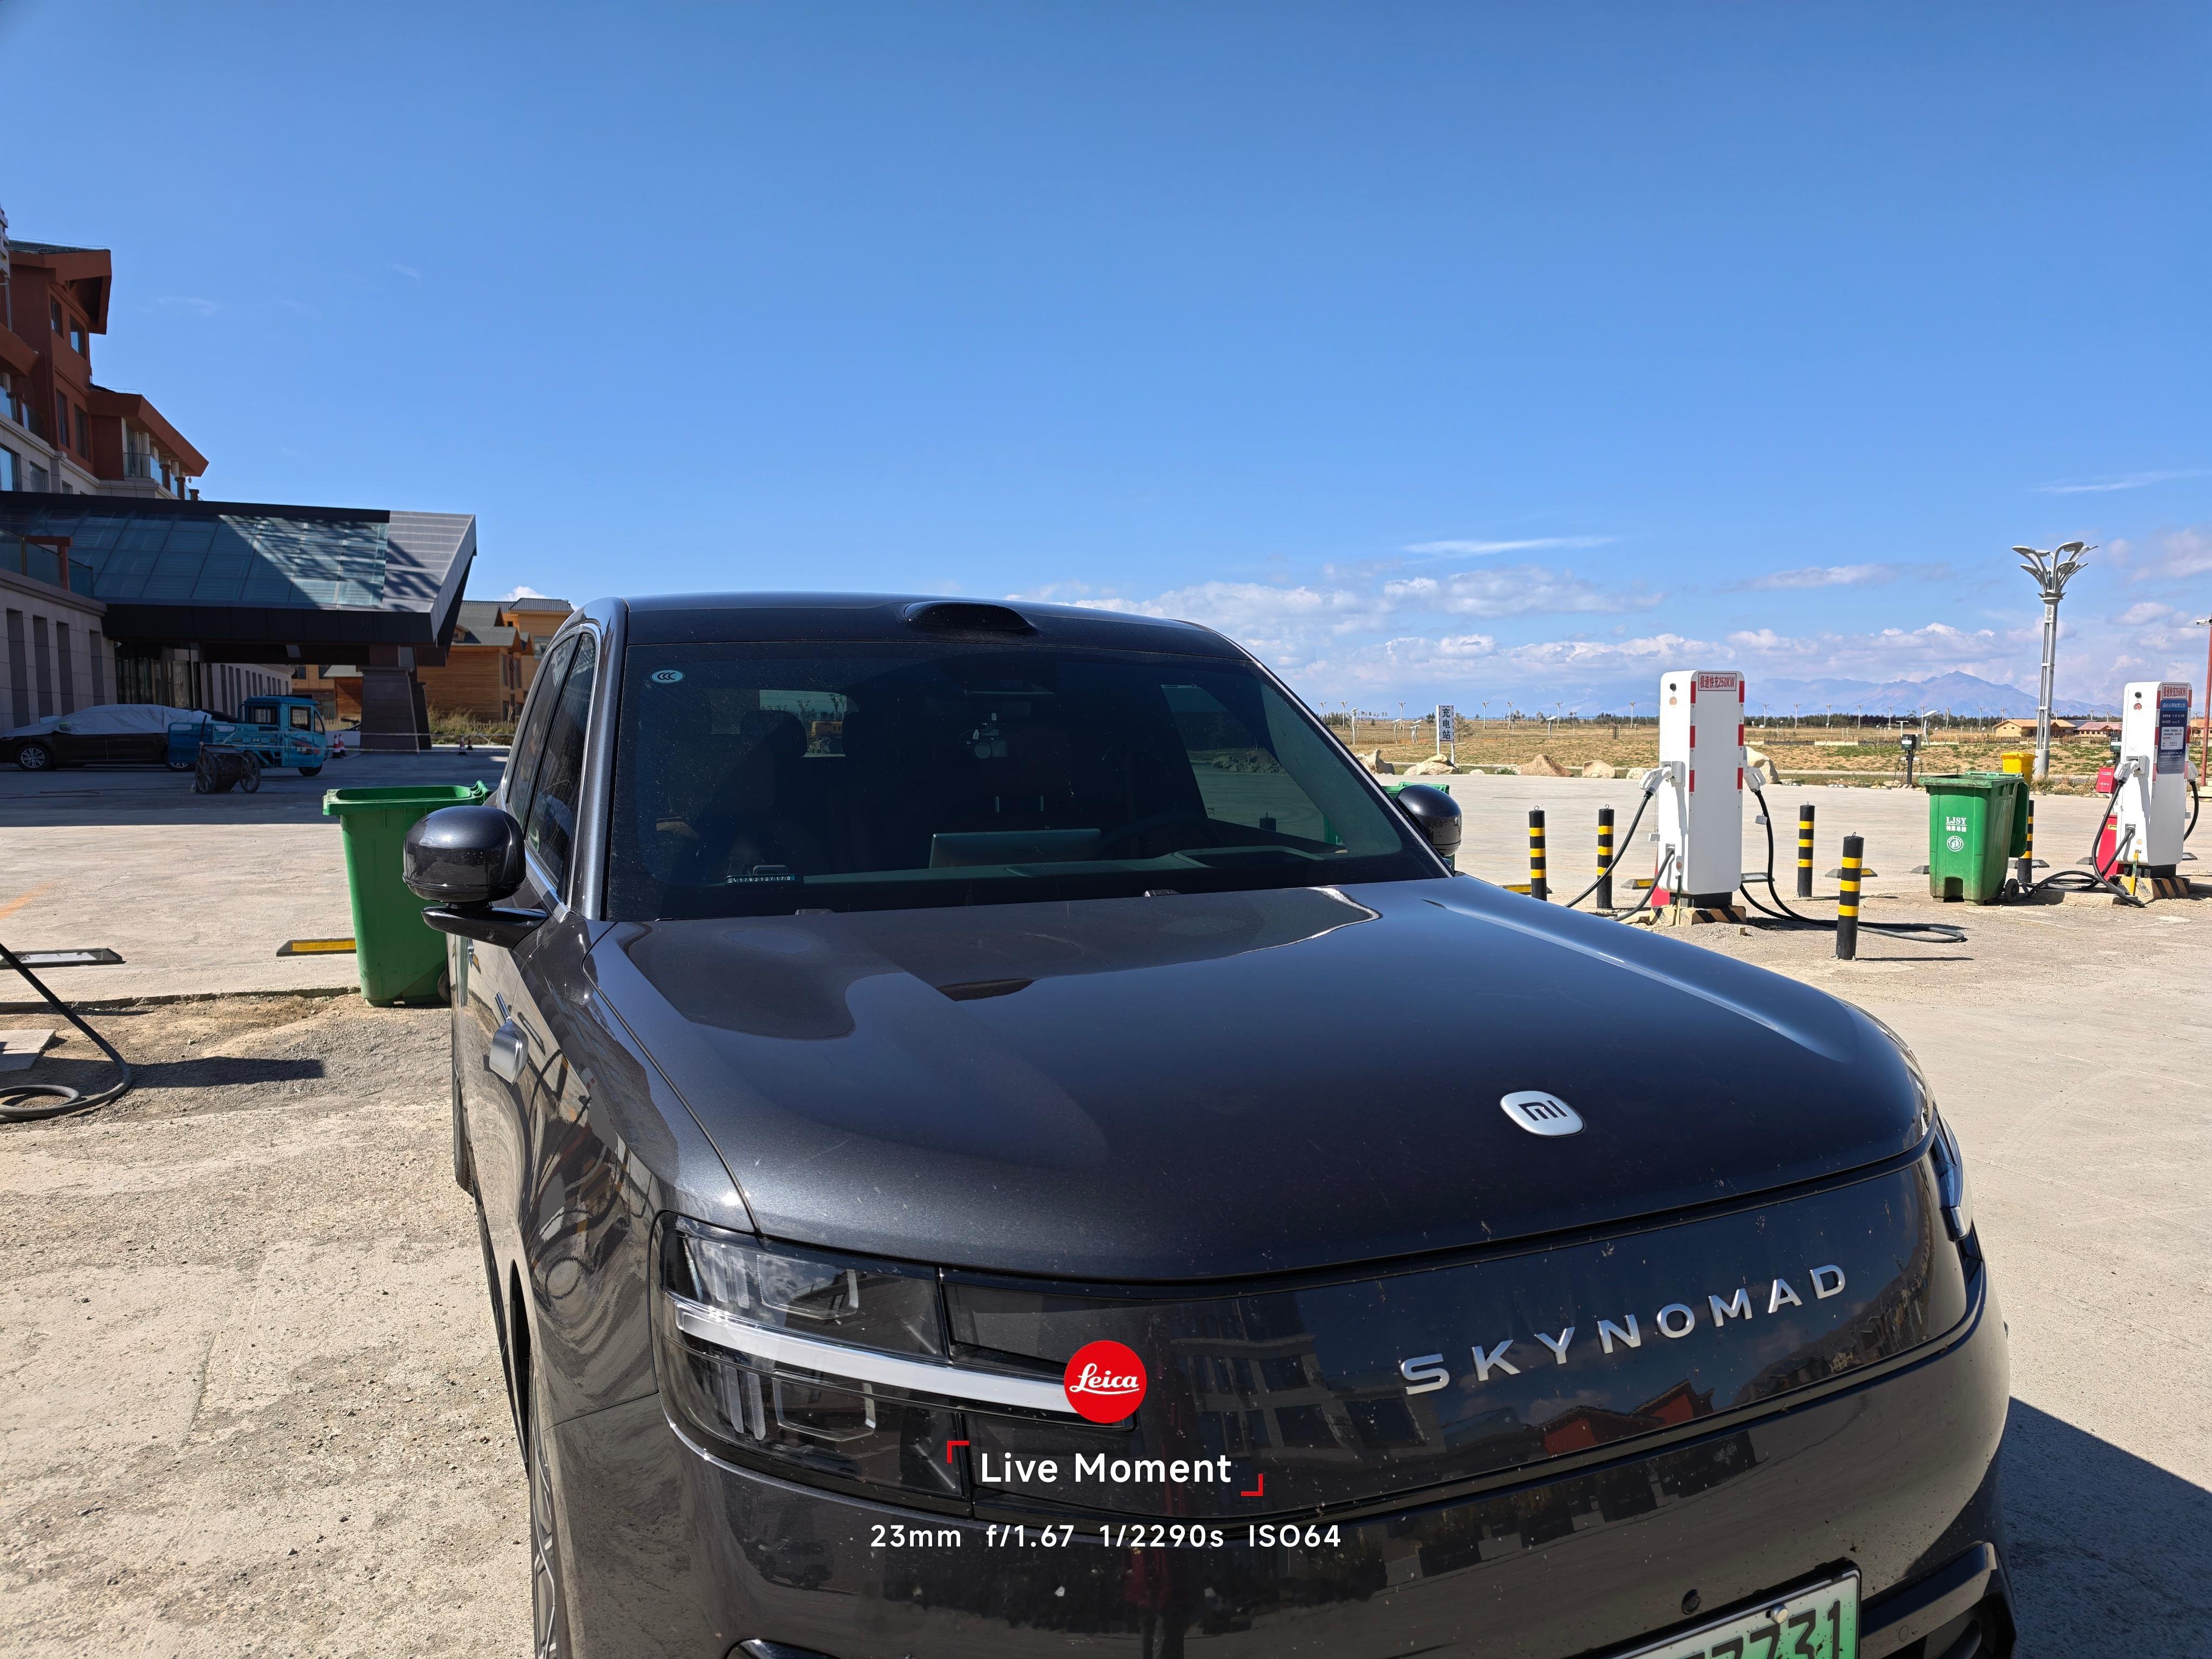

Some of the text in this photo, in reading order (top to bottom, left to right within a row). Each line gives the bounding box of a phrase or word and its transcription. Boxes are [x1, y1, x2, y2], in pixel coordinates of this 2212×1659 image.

[1442, 707, 1451, 740] 充电站
[1946, 816, 1967, 825] LJSY
[1400, 1264, 1846, 1395] SKYNOMAD
